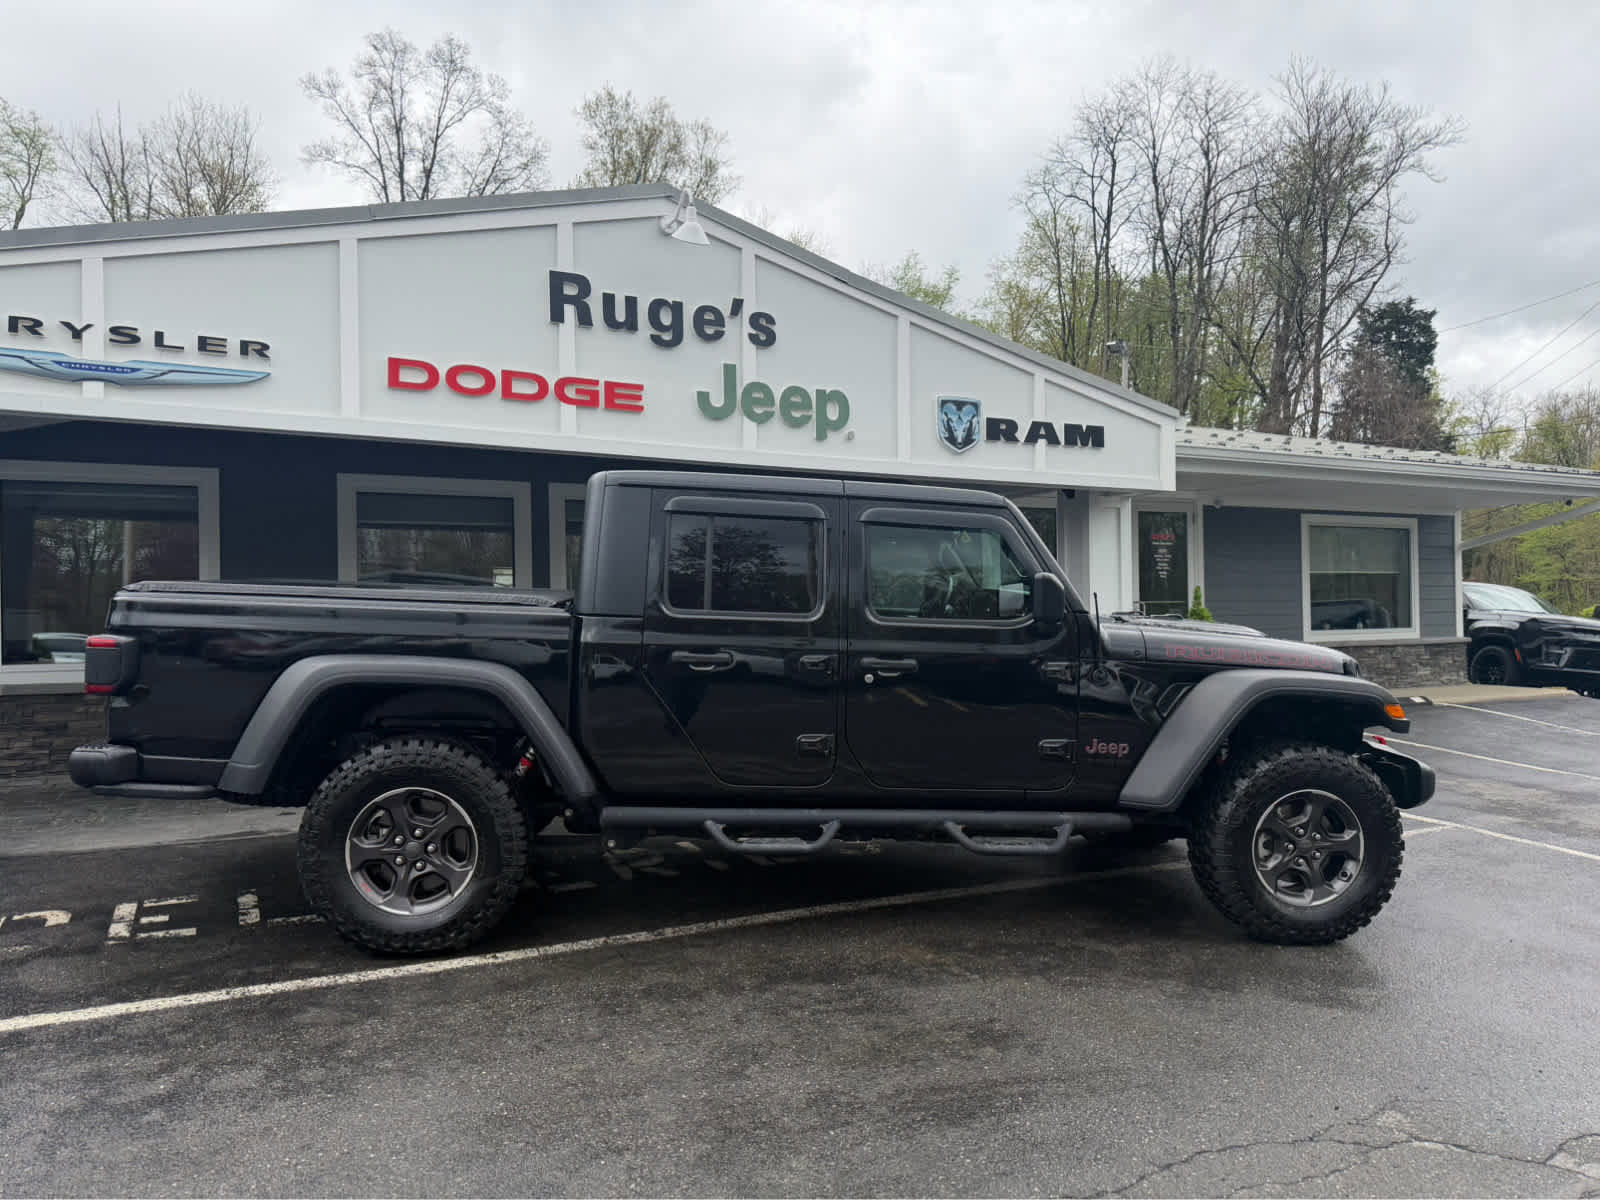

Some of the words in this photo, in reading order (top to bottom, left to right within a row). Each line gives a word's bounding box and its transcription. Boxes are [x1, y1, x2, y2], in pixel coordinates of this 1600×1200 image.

[549, 270, 777, 348] Ruge's
[8, 315, 271, 358] RYSLER
[387, 357, 644, 412] DODGE
[697, 363, 850, 441] Jeep
[986, 417, 1105, 448] RAM
[1086, 738, 1129, 757] Jeep
